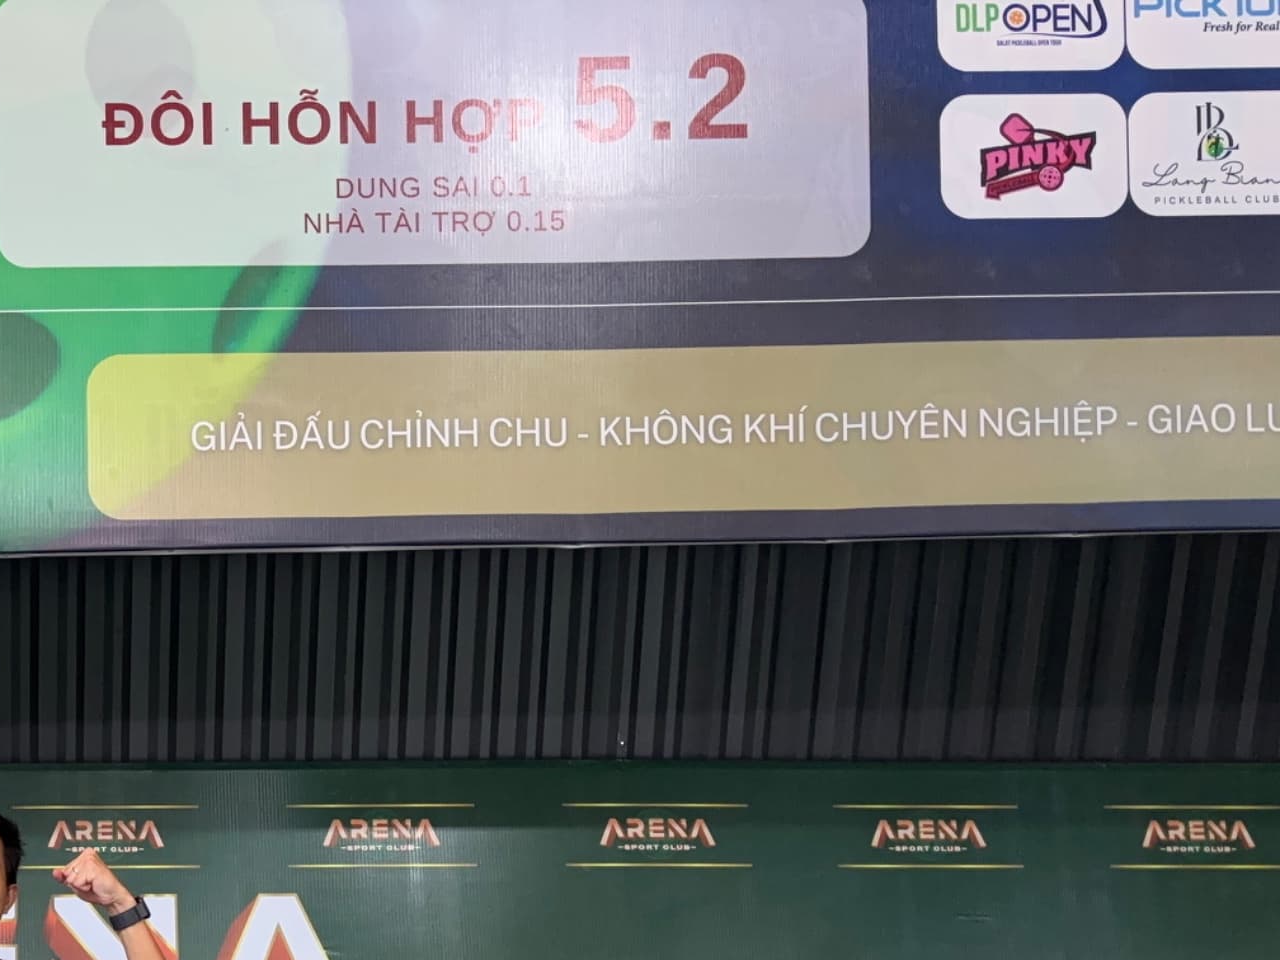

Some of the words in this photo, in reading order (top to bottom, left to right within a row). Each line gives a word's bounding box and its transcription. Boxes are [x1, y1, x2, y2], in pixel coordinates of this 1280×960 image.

[1203, 22, 1232, 32] Fresh
[1234, 21, 1252, 34] for
[102, 90, 214, 147] ĐÔI
[242, 89, 376, 147] HỖN
[407, 97, 544, 154] HỢP
[574, 53, 749, 144] 5.2
[985, 137, 1092, 181] PINKY
[1221, 161, 1280, 185] Bian
[335, 177, 420, 200] DUNG
[432, 176, 478, 200] SAI
[490, 175, 532, 198] 0.1
[1154, 197, 1238, 205] PICKLEBALL
[304, 207, 364, 235] NHÀ
[377, 207, 422, 234] TÀI
[433, 209, 497, 236] TRỢ
[507, 210, 566, 232] 0.15
[191, 411, 263, 451] GIẢI
[273, 410, 351, 450] ĐẤU
[361, 409, 478, 449] CHỈNH
[489, 418, 568, 448] CHU
[600, 409, 733, 447] KHÔNG
[744, 405, 806, 443] KHÍ
[815, 403, 968, 442] CHUYÊN
[979, 400, 1118, 443] NGHIỆP
[1148, 403, 1235, 435] GIAO
[48, 820, 164, 849] ARENA
[323, 818, 440, 847] ARENA
[600, 818, 715, 848] ARENA
[871, 819, 986, 848] ARENA
[1142, 819, 1255, 849] ARENA
